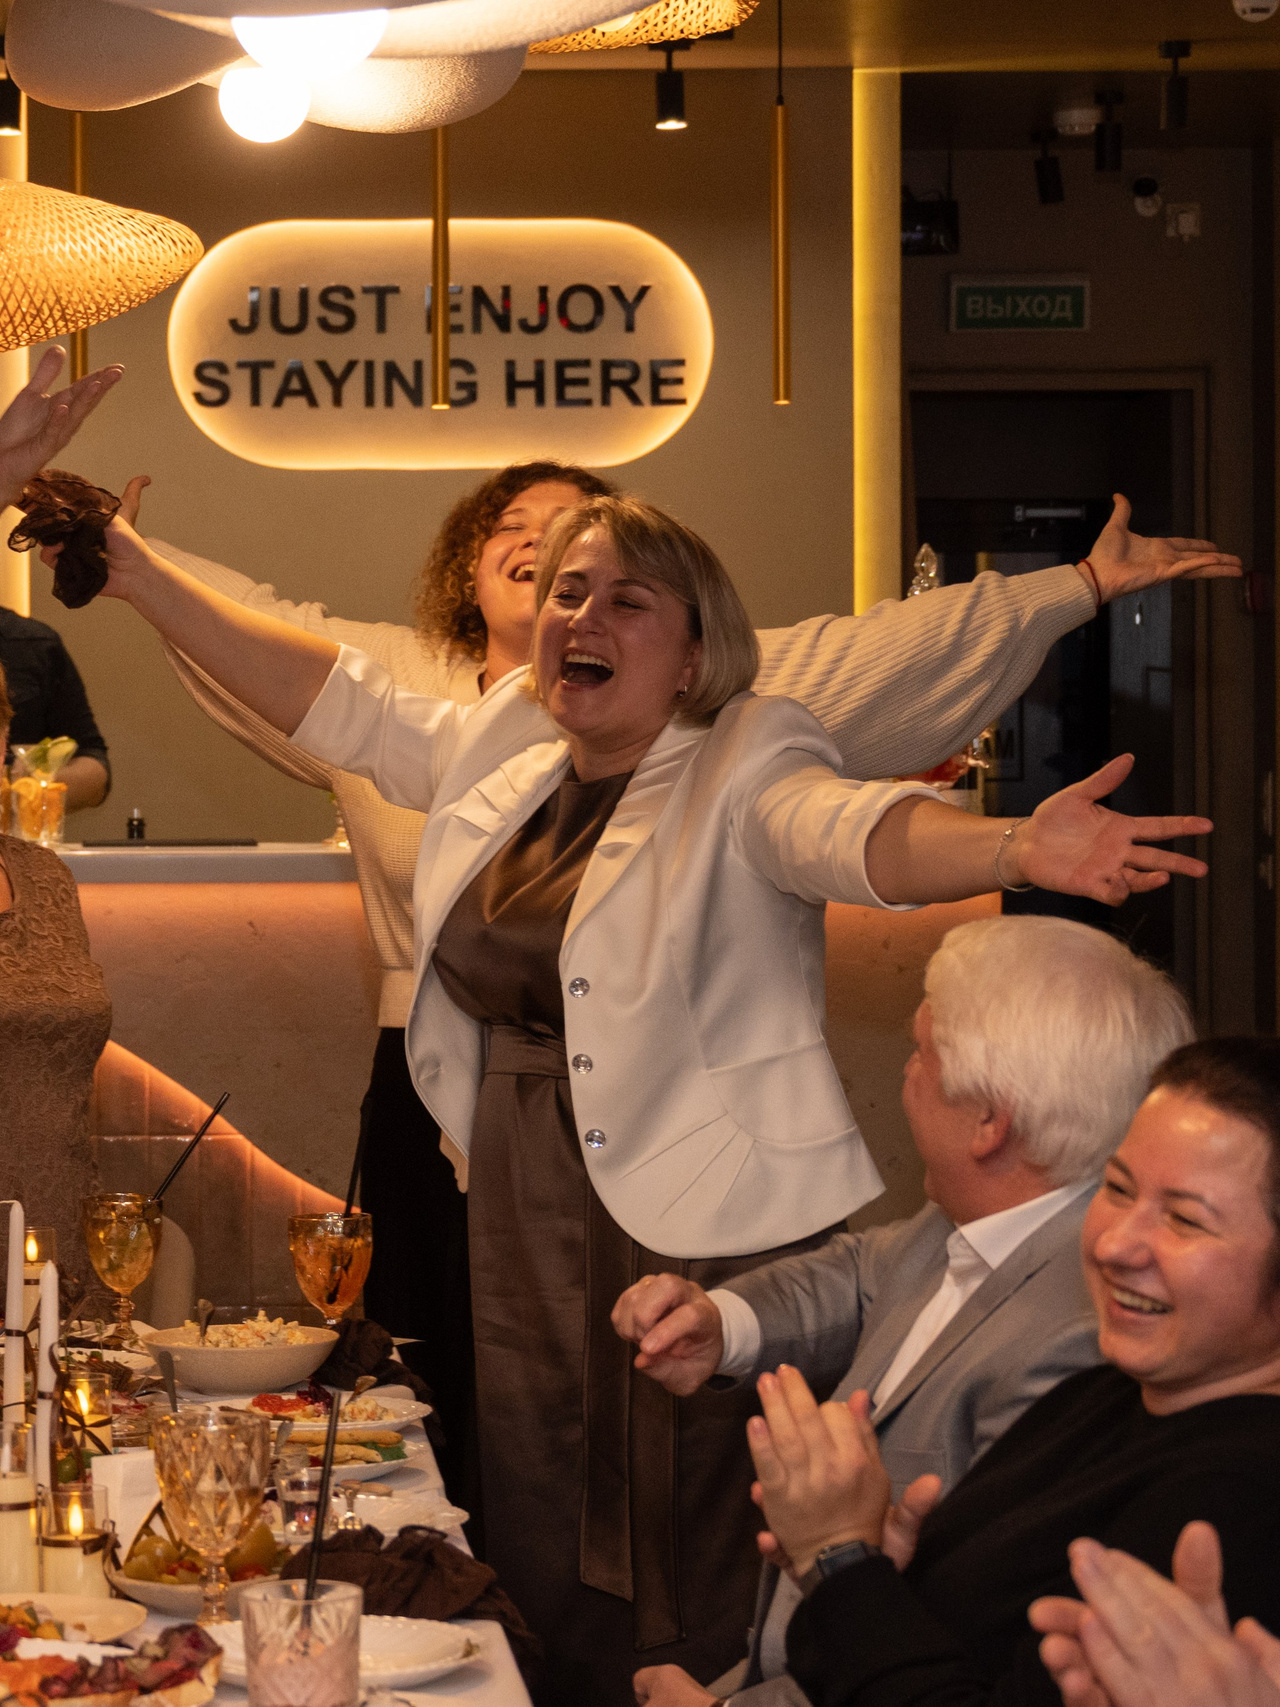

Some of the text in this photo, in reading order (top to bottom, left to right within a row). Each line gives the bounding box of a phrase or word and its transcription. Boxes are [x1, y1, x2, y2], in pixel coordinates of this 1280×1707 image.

[229, 284, 651, 335] JUST ENJOY
[966, 294, 1073, 321] ВЫХОД
[192, 358, 688, 408] STAYING HERE
